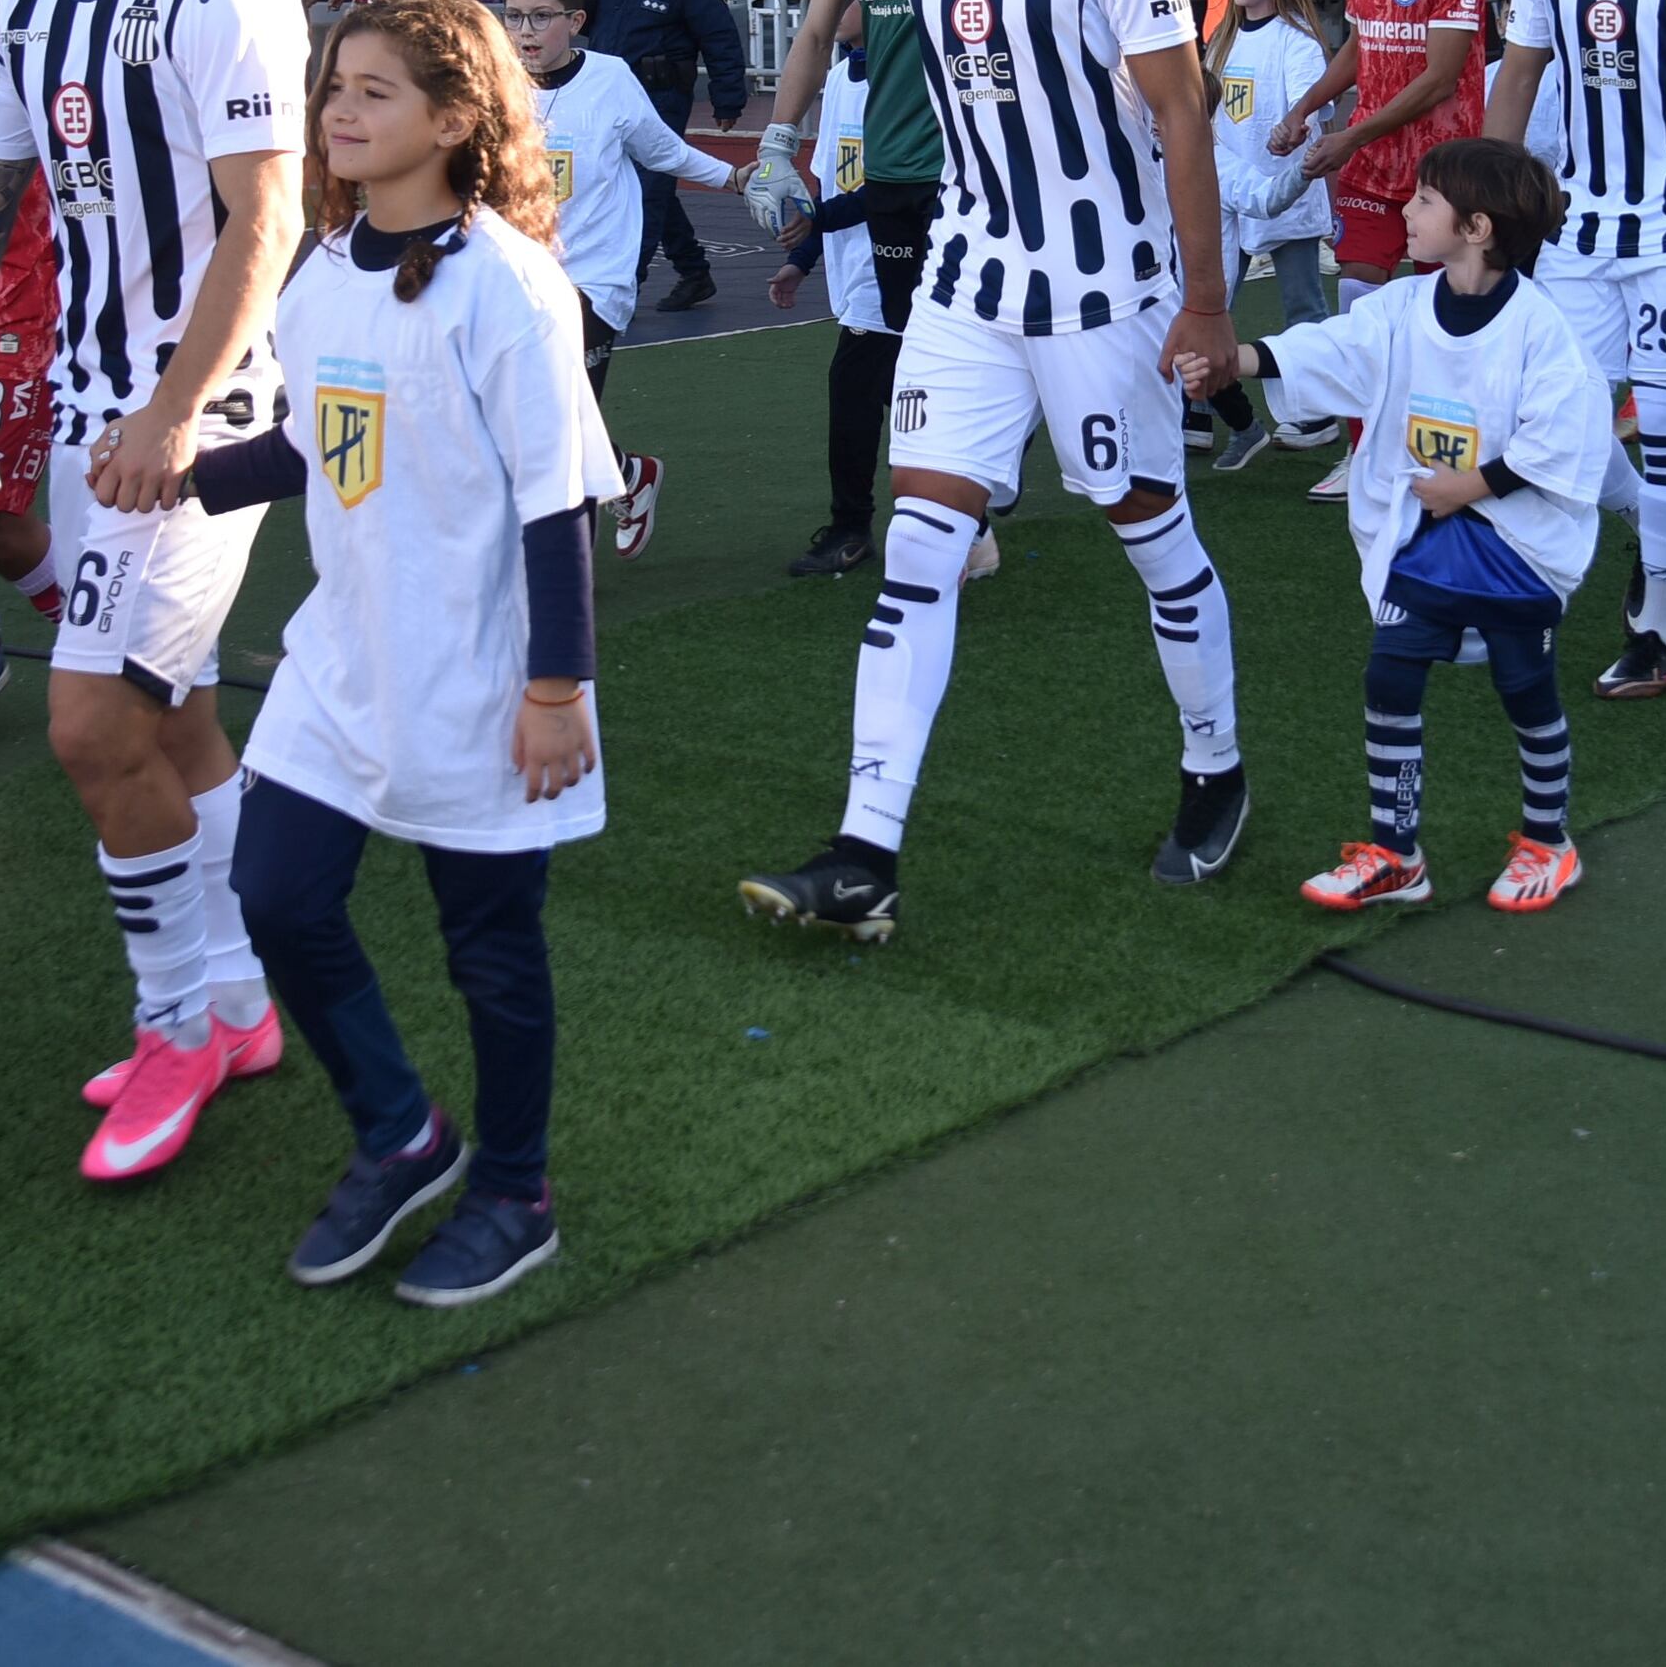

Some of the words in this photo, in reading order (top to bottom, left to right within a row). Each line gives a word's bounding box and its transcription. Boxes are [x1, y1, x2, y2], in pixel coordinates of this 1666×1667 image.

[947, 53, 1011, 81] ICBC
[1591, 48, 1645, 71] ICBC
[958, 86, 1015, 104] rgentina
[1081, 413, 1118, 472] 6
[68, 550, 108, 626] 6
[98, 550, 134, 635] GIVOVA
[1396, 761, 1417, 835] TALLERES
